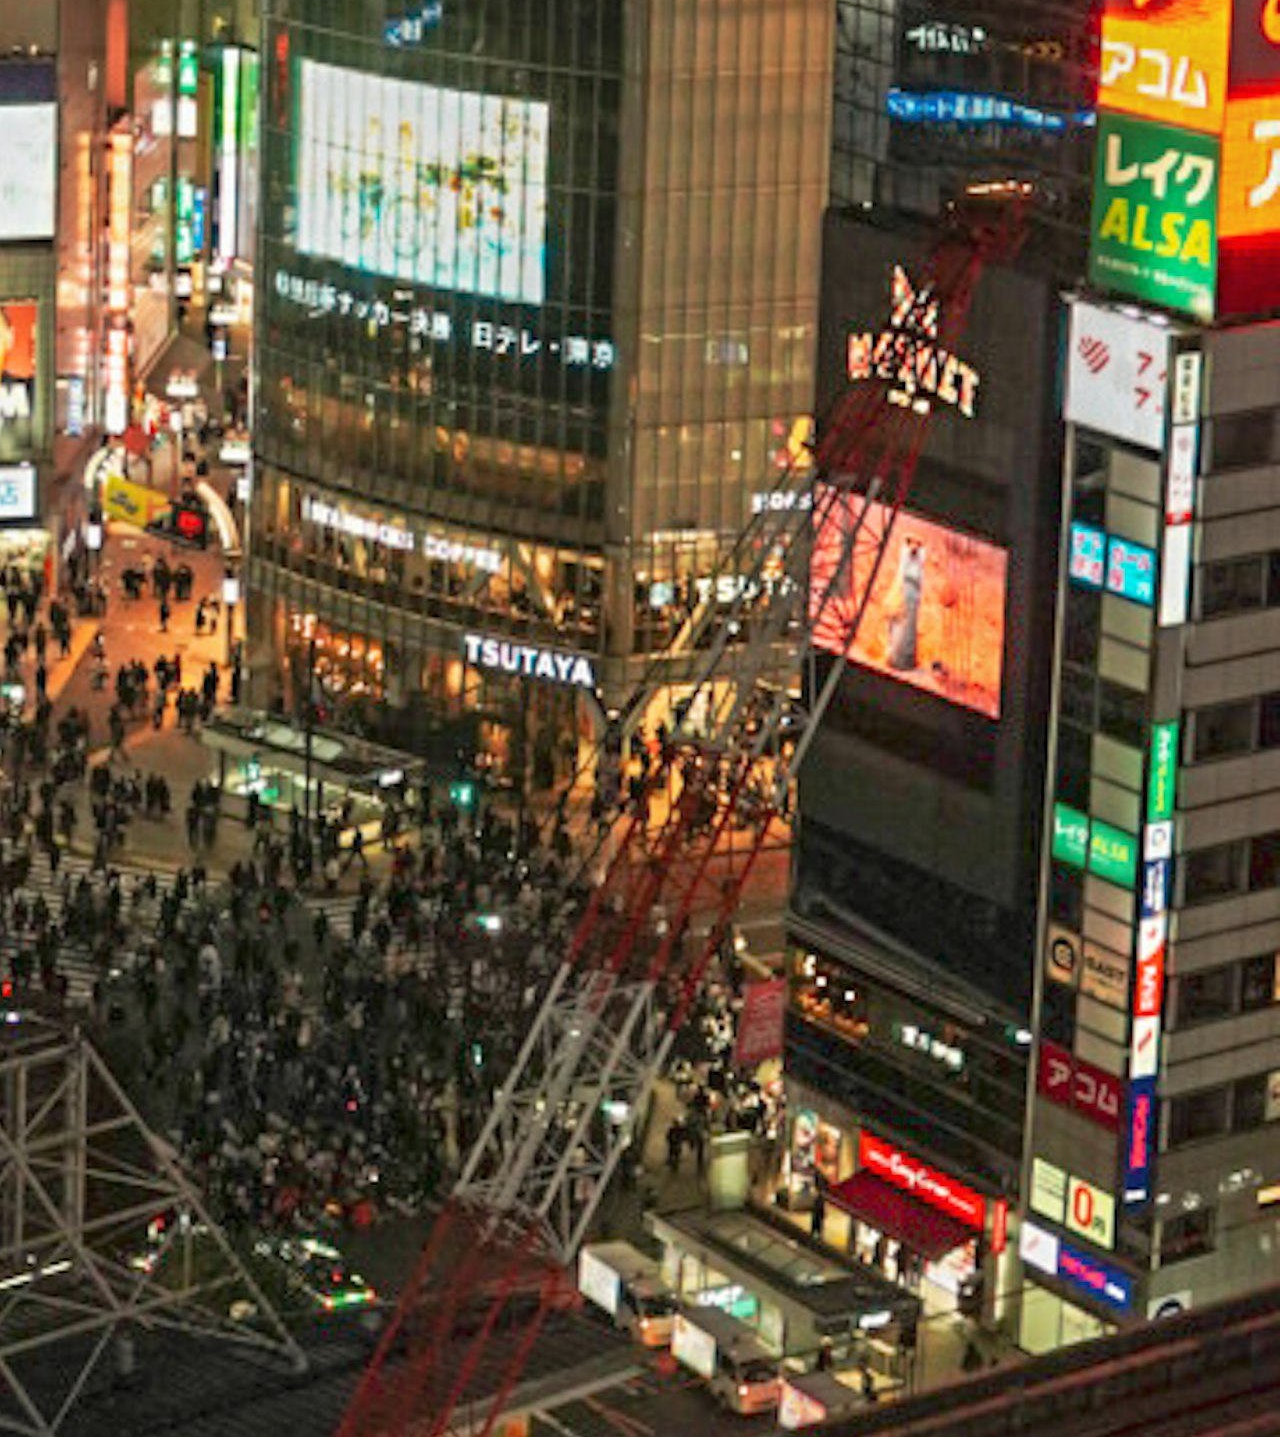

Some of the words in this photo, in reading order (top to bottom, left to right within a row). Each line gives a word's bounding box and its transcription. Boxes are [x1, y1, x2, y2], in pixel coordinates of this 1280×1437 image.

[1100, 39, 1208, 108] アコム
[1104, 133, 1216, 207] レイク
[1099, 196, 1212, 268] ALSA
[462, 635, 595, 687] TSUTAYA
[1047, 1057, 1118, 1117] アコム
